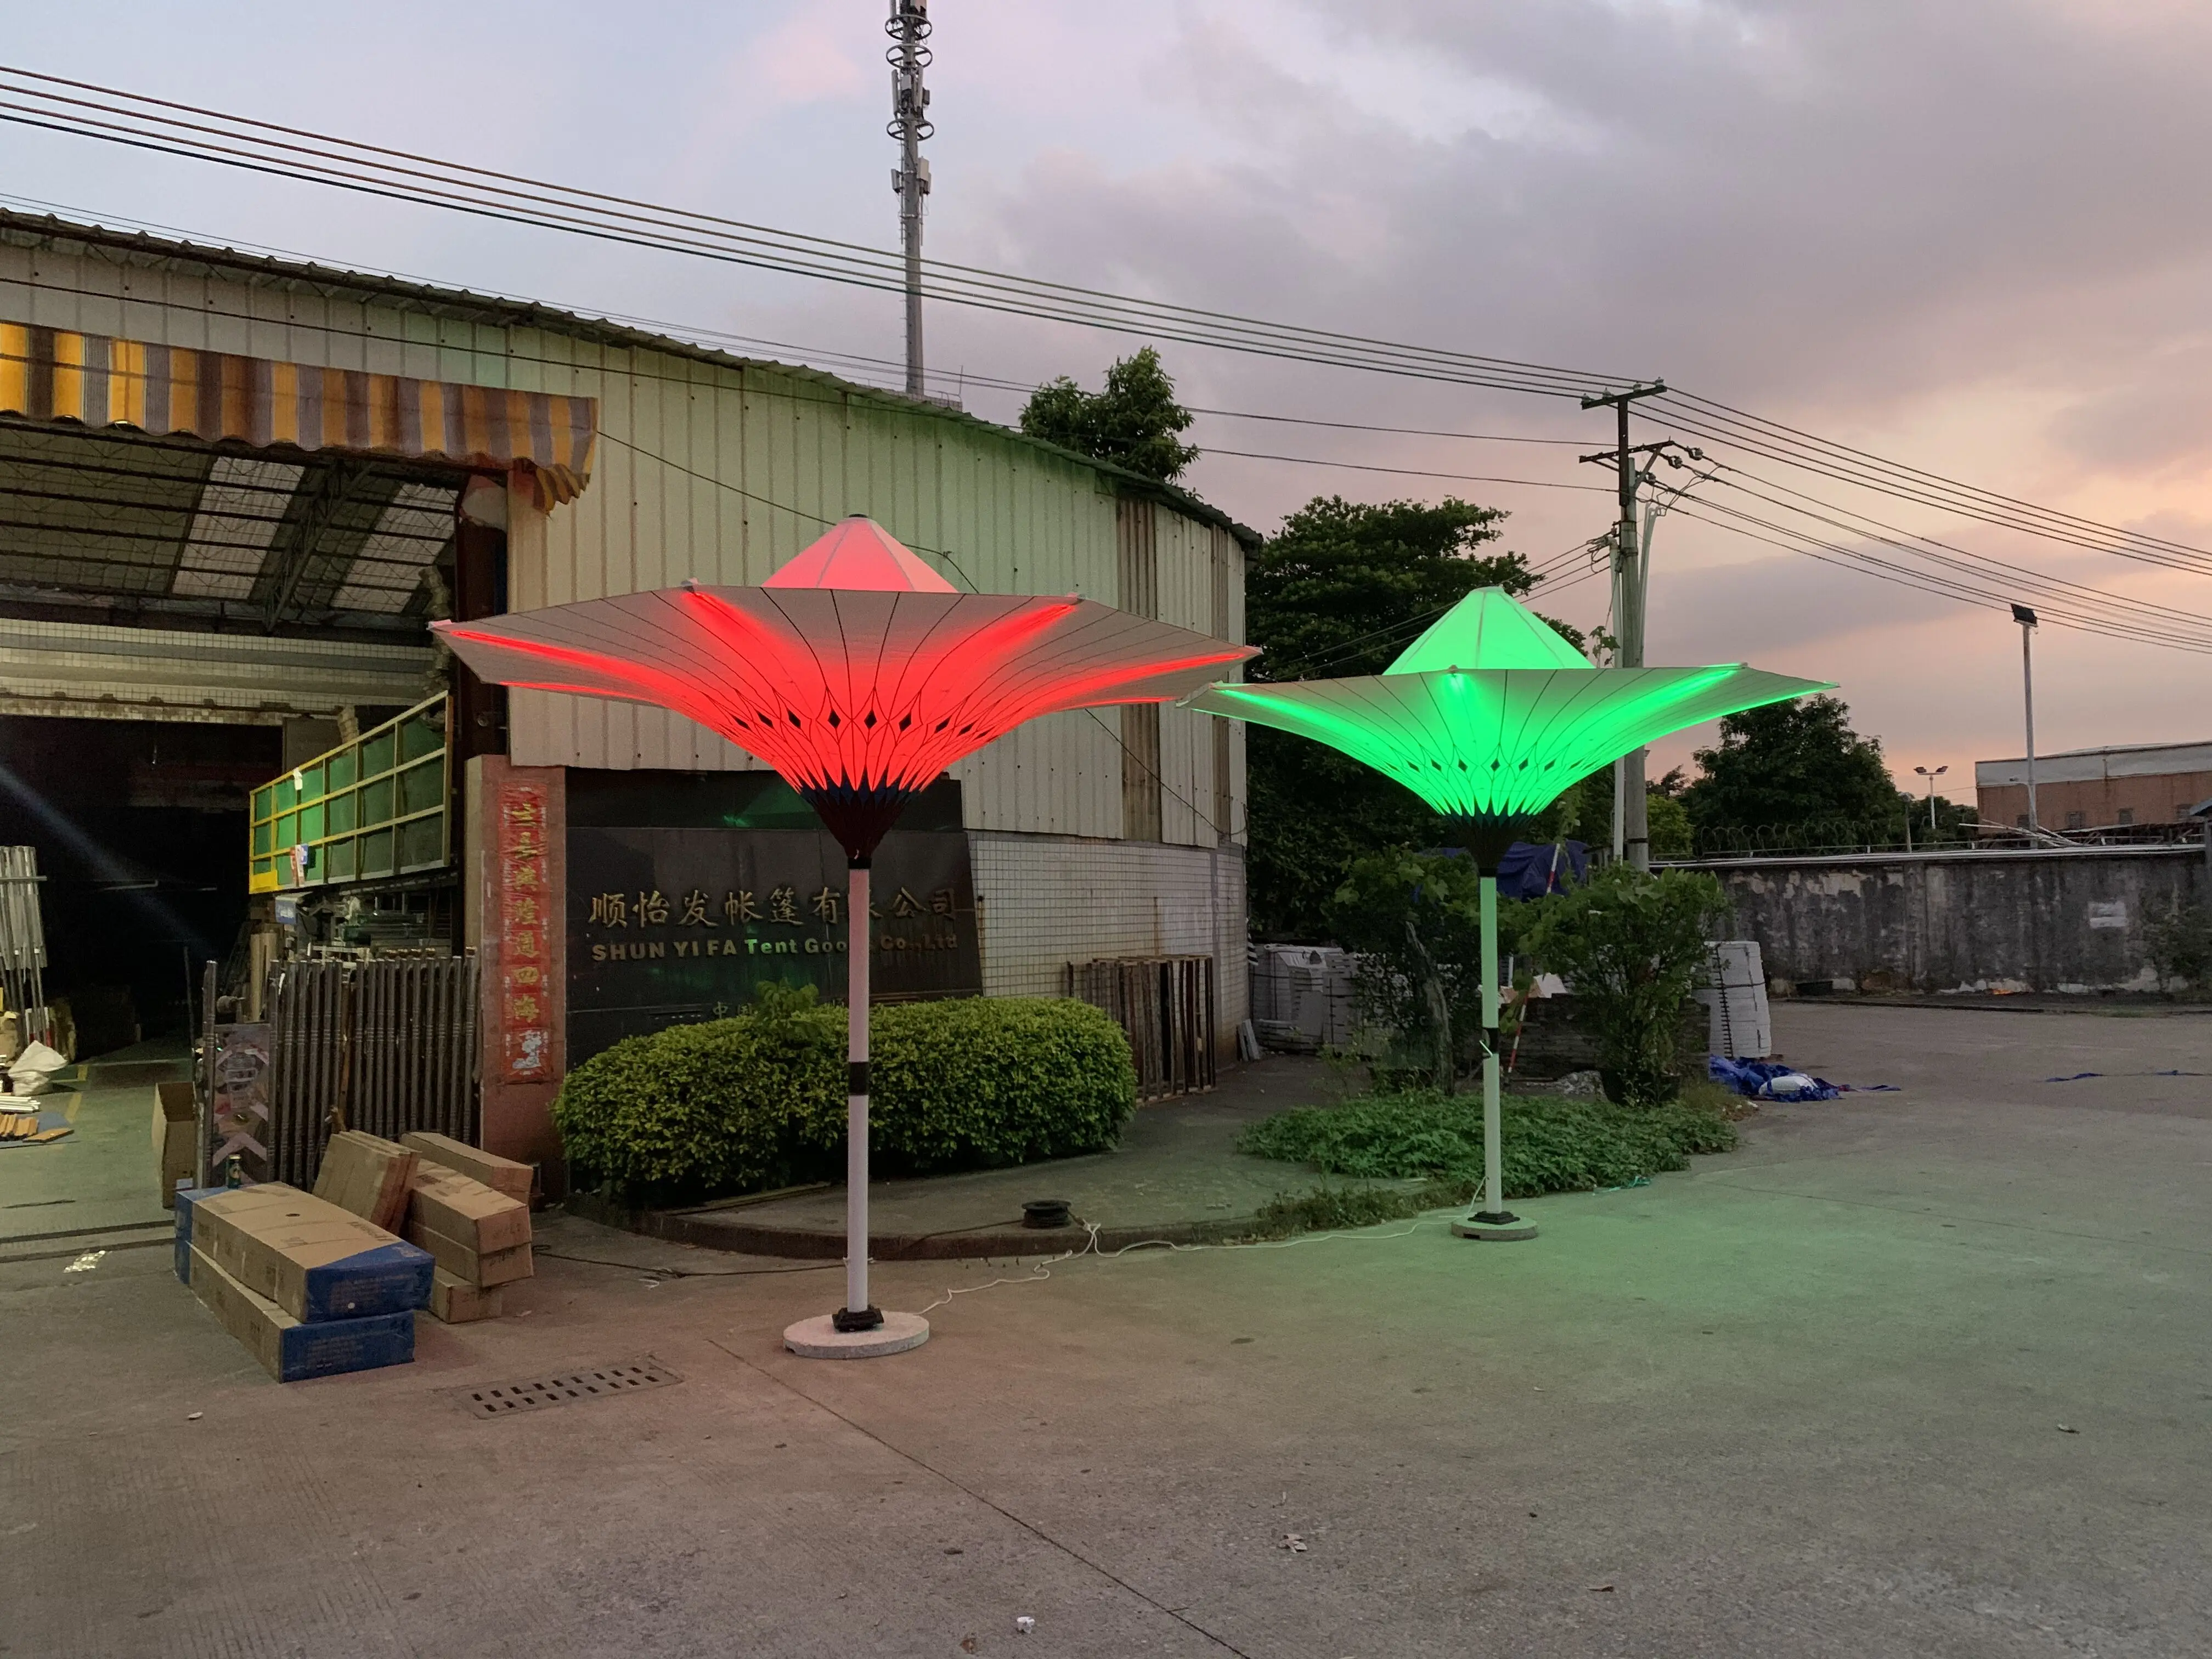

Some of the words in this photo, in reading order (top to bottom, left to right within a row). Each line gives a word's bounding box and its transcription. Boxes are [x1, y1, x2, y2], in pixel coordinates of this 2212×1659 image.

[591, 941, 664, 961] SHUN
[673, 940, 699, 957] YI
[707, 939, 737, 956] FA
[743, 939, 798, 955] Tent
[804, 937, 876, 954] Goo
